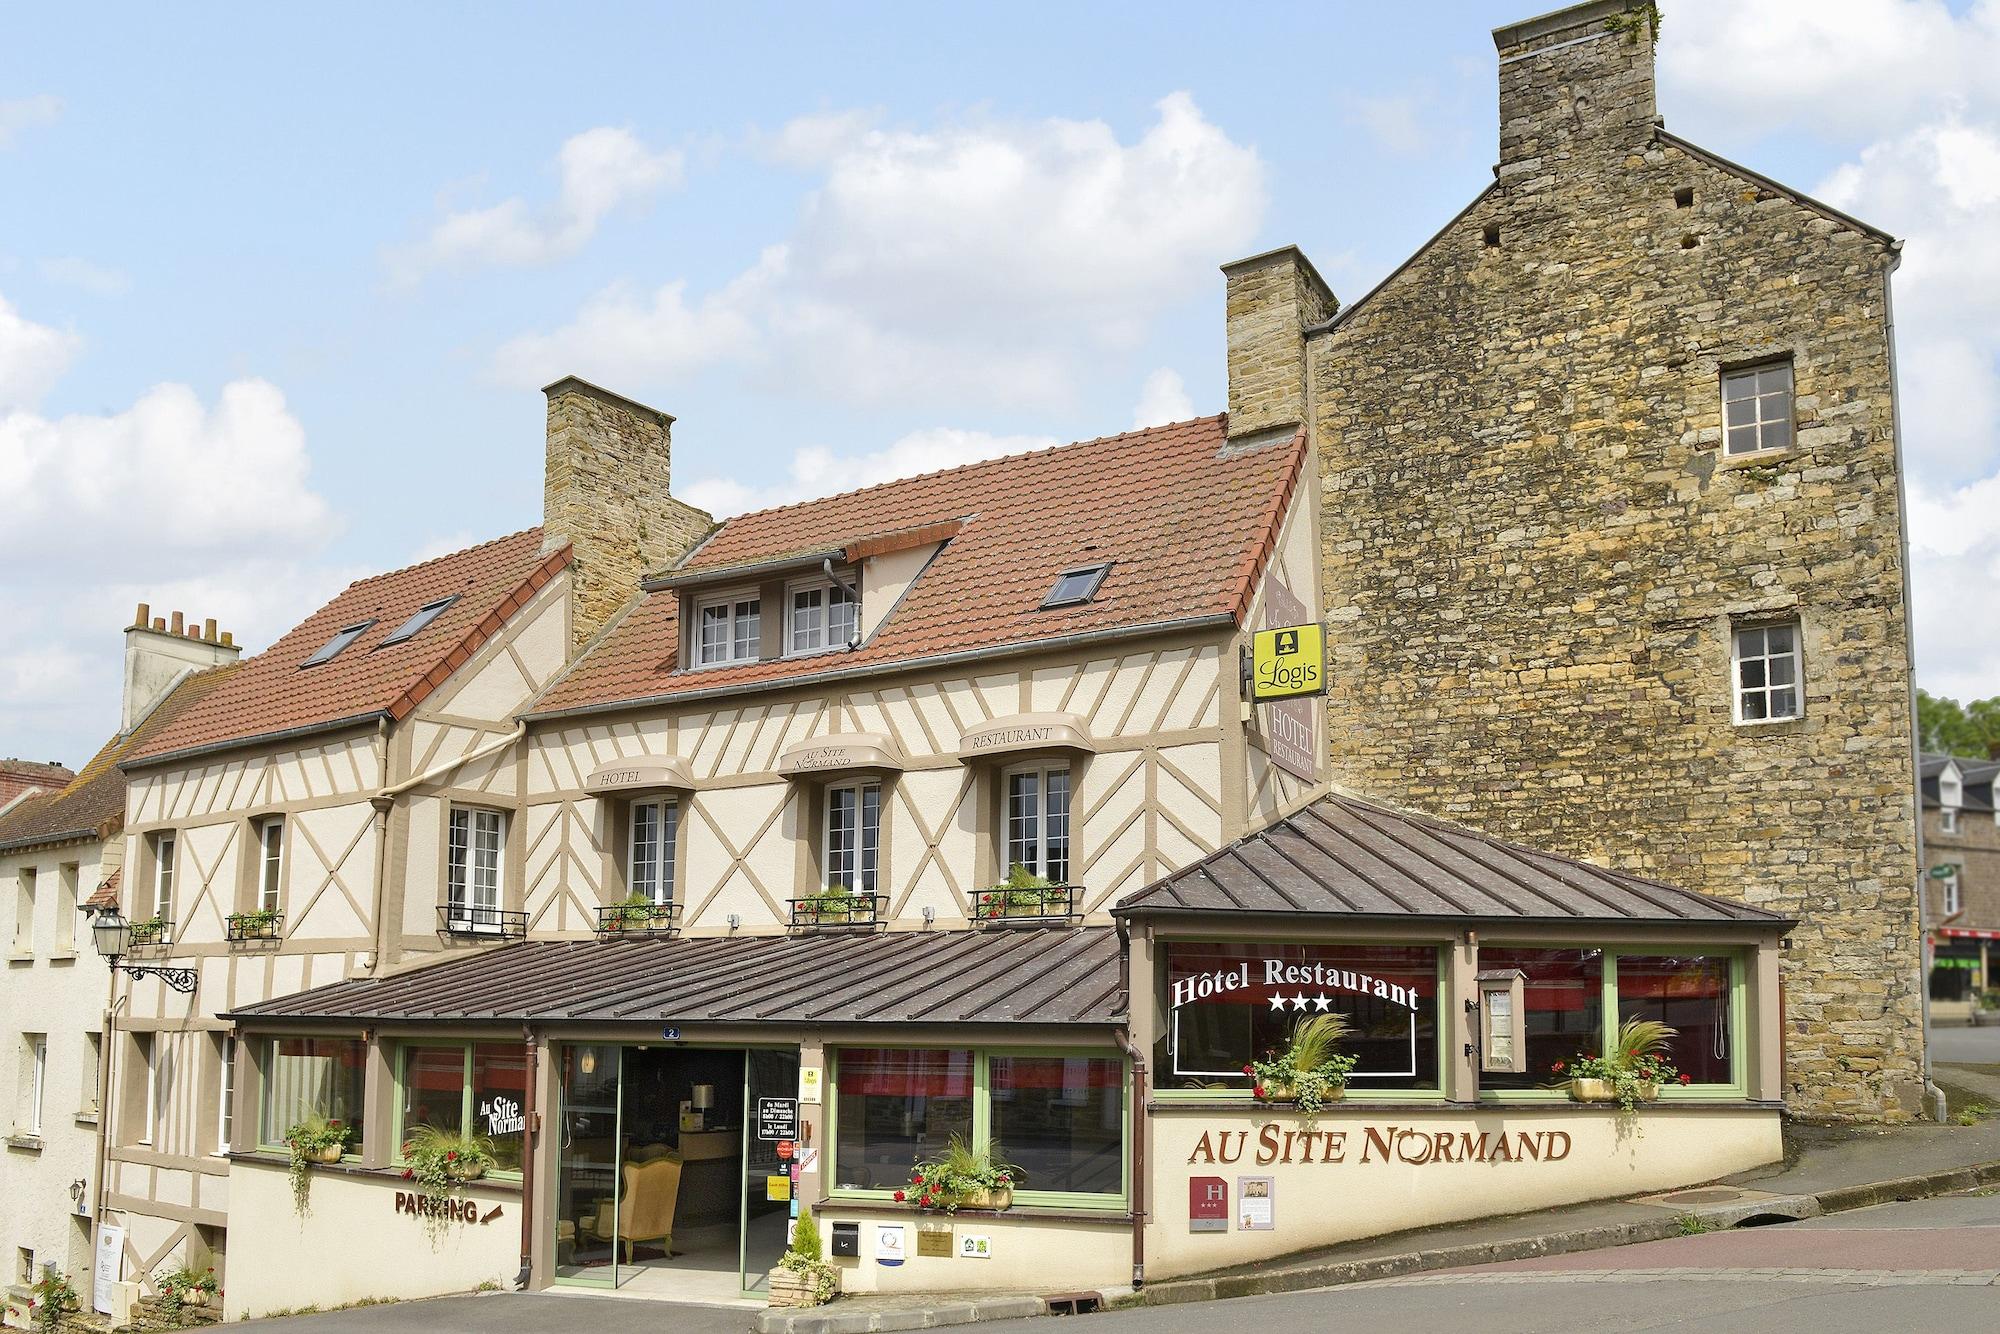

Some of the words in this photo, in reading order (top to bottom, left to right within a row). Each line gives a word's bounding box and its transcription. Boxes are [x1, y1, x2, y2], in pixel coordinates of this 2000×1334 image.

[1257, 656, 1317, 690] Logis
[972, 727, 1053, 749] RESTAURANT
[1271, 704, 1313, 755] HOTEL
[793, 758, 851, 770] NORMAND
[803, 751, 819, 760] AU
[820, 747, 846, 758] SITE
[1273, 738, 1313, 775] RESTAURANT
[600, 771, 641, 785] HOTEL
[1171, 962, 1250, 1010] Hôtel
[1263, 959, 1419, 1011] Restaurant
[668, 1028, 675, 1038] 2
[480, 1101, 490, 1116] Au
[493, 1096, 518, 1121] Site
[1187, 1129, 1250, 1165] AU
[1254, 1123, 1347, 1166] SITE
[1358, 1125, 1572, 1165] NORMAND
[1206, 1184, 1224, 1201] H
